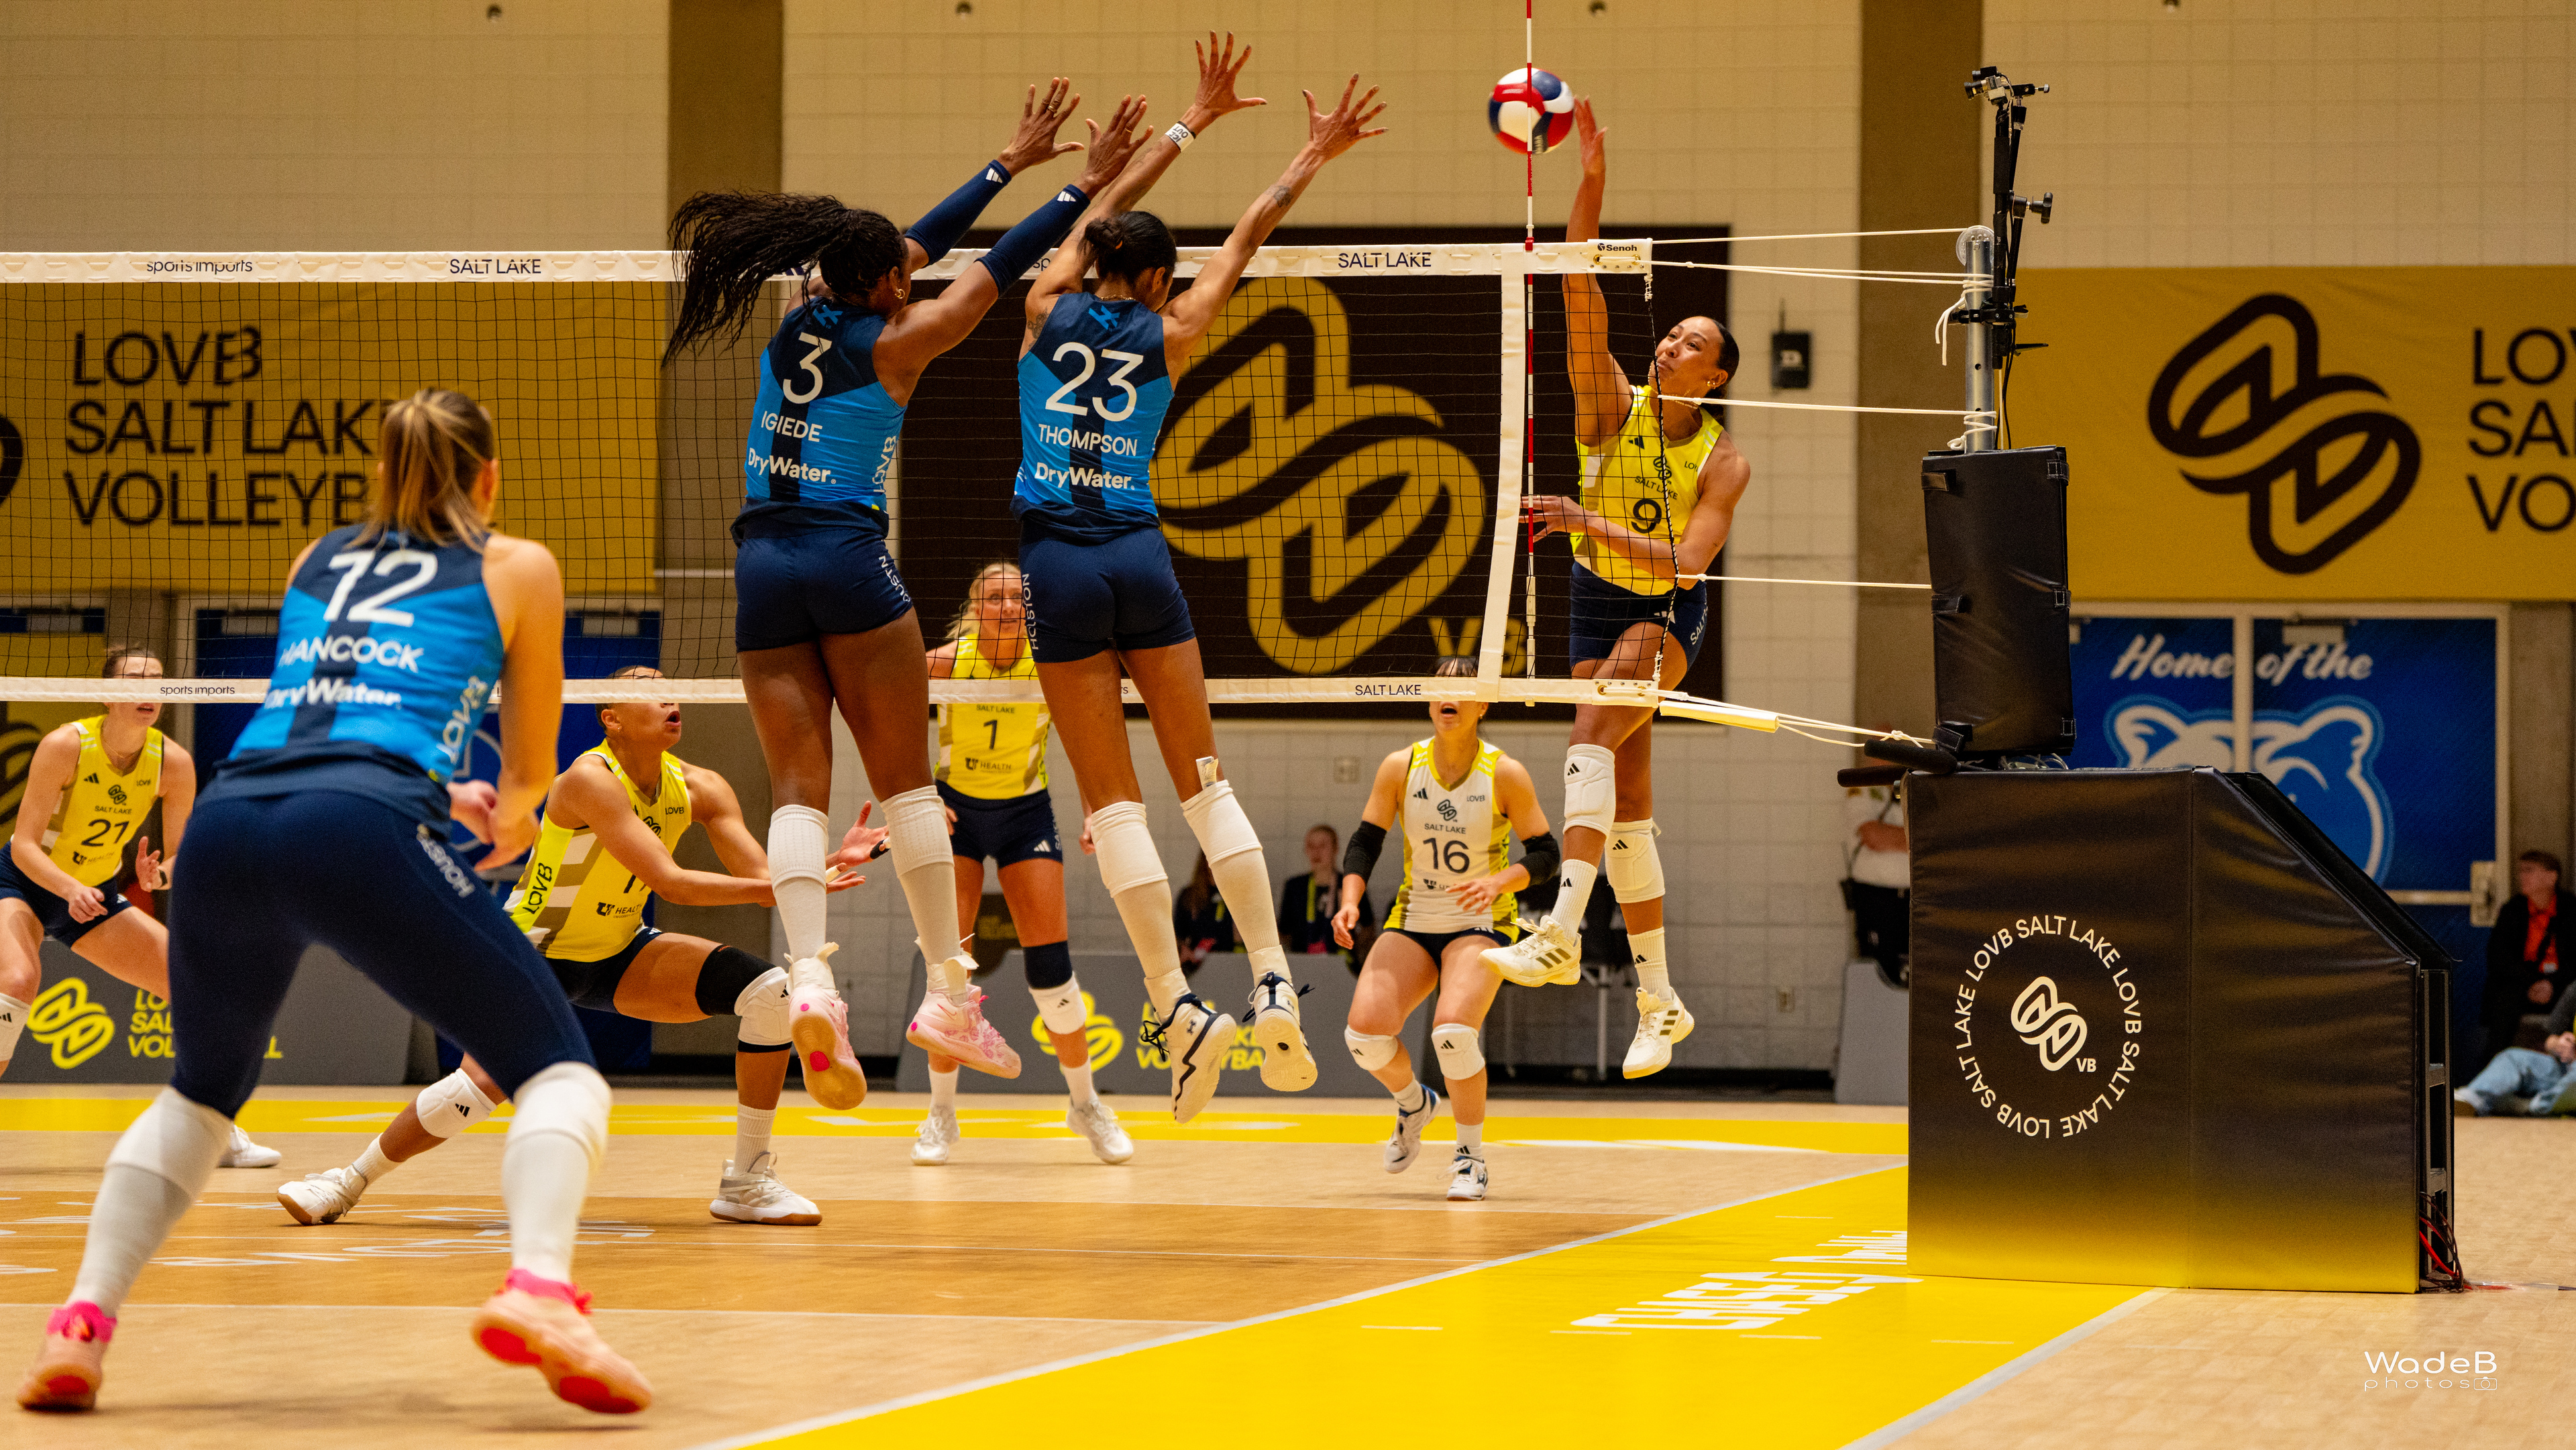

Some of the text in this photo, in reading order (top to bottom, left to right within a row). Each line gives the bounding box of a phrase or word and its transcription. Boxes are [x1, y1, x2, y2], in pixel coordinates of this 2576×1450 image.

[147, 260, 253, 274] sports imports
[449, 259, 541, 274] SALT LAKE
[1338, 252, 1432, 268] SALT LAKE
[73, 325, 262, 386] LOVB
[783, 332, 833, 404] 3
[2473, 328, 2576, 385] LO
[1045, 342, 1144, 422] 23
[65, 400, 386, 455] SALT LAK
[761, 410, 823, 443] IGIEDE
[1038, 424, 1138, 457] THOMPSON
[2468, 401, 2576, 457] SA
[871, 436, 896, 494] LOVB
[64, 471, 369, 526] VOLLEYB
[1635, 476, 1657, 490] SALT
[1631, 498, 1662, 534] 9
[323, 549, 438, 628] 12
[278, 635, 424, 673] HANCOCK
[2110, 633, 2373, 686] Home of the
[160, 685, 235, 696] sports imports
[1355, 684, 1421, 695] SALT LAKE
[976, 704, 1015, 714] SALT LAKE
[983, 719, 998, 750] 1
[980, 760, 1012, 771] HEALTH
[95, 805, 133, 815] SALT LAKE
[665, 807, 685, 815] LOVB
[80, 818, 130, 847] 21
[1424, 823, 1466, 834] SALT LAKE
[1423, 838, 1470, 874] 16
[523, 862, 552, 915] LOVB
[1954, 915, 2142, 1139] LOVB SALT LAKE LOVB SALT LAKE LOVB SALT LAKE
[2076, 1058, 2097, 1073] VB
